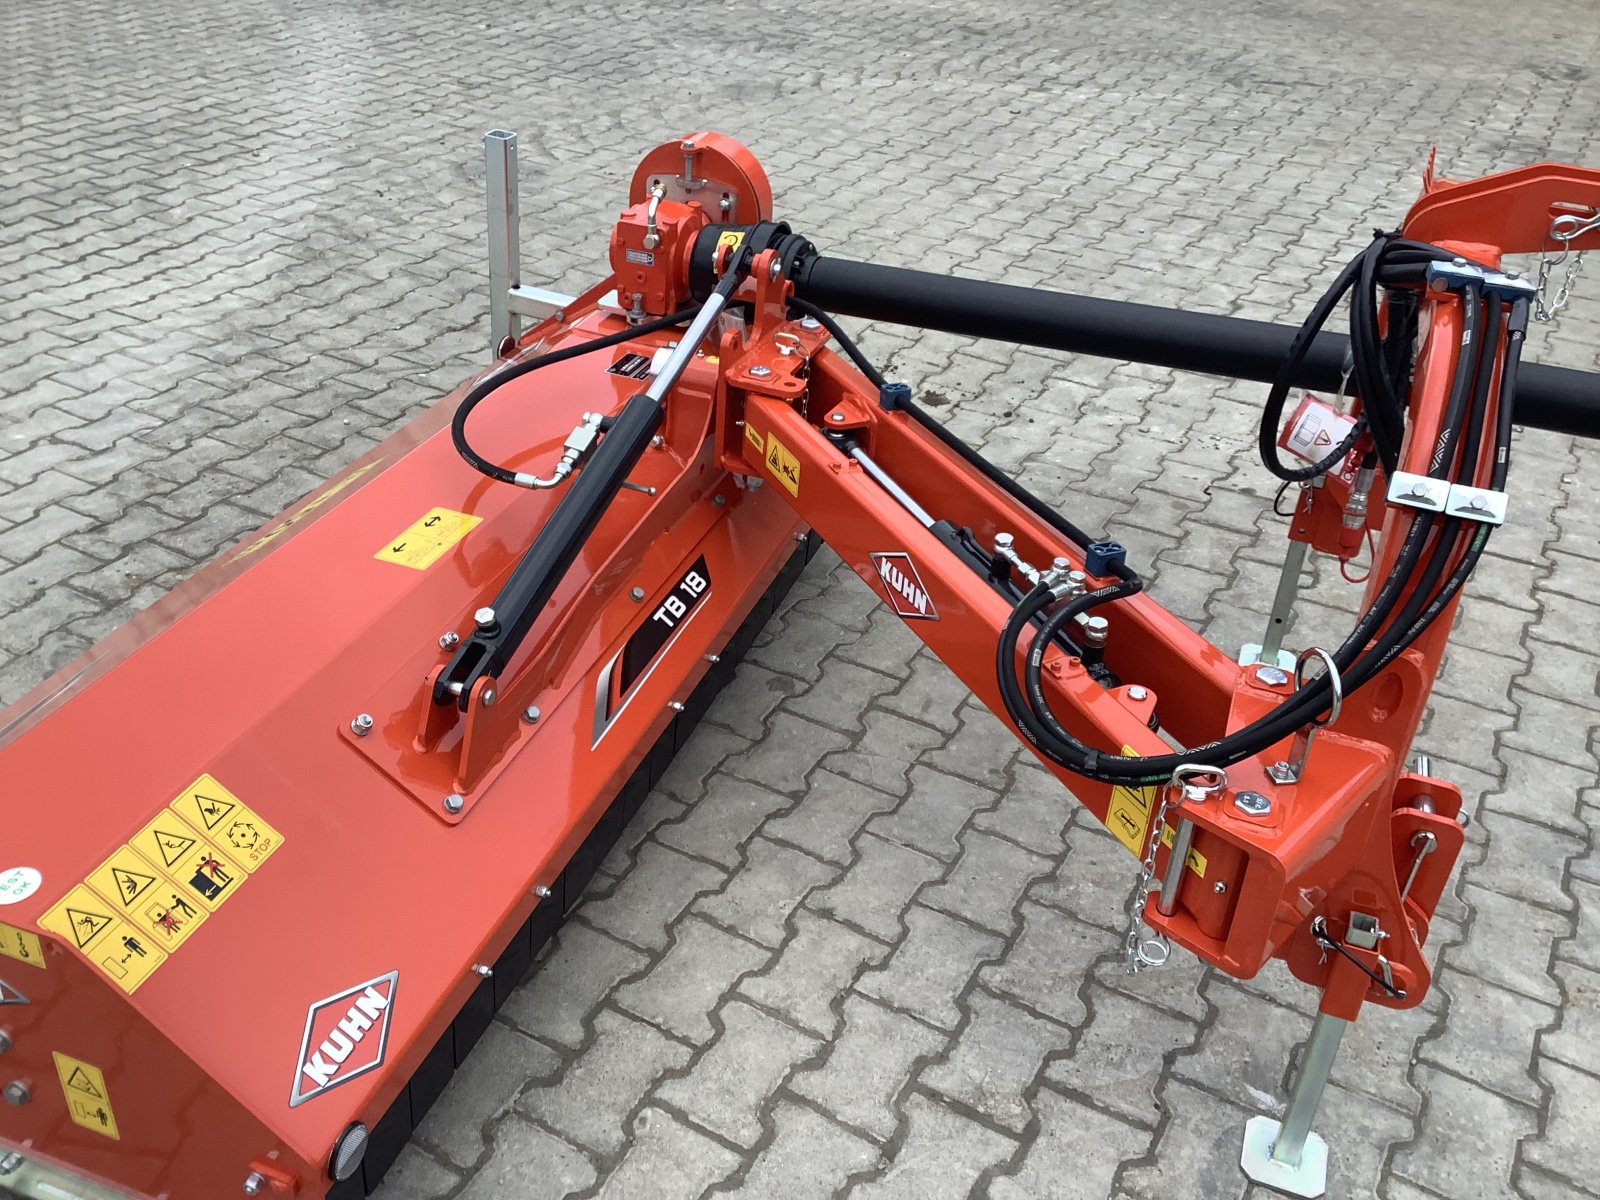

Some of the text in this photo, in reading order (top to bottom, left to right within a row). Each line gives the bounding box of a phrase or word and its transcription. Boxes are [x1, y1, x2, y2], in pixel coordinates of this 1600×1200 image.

[653, 570, 707, 628] TB 18
[880, 556, 927, 615] KUHN
[249, 838, 271, 861] STOP
[0, 870, 24, 896] EST
[13, 881, 32, 895] OK
[302, 985, 390, 1089] KUHN
